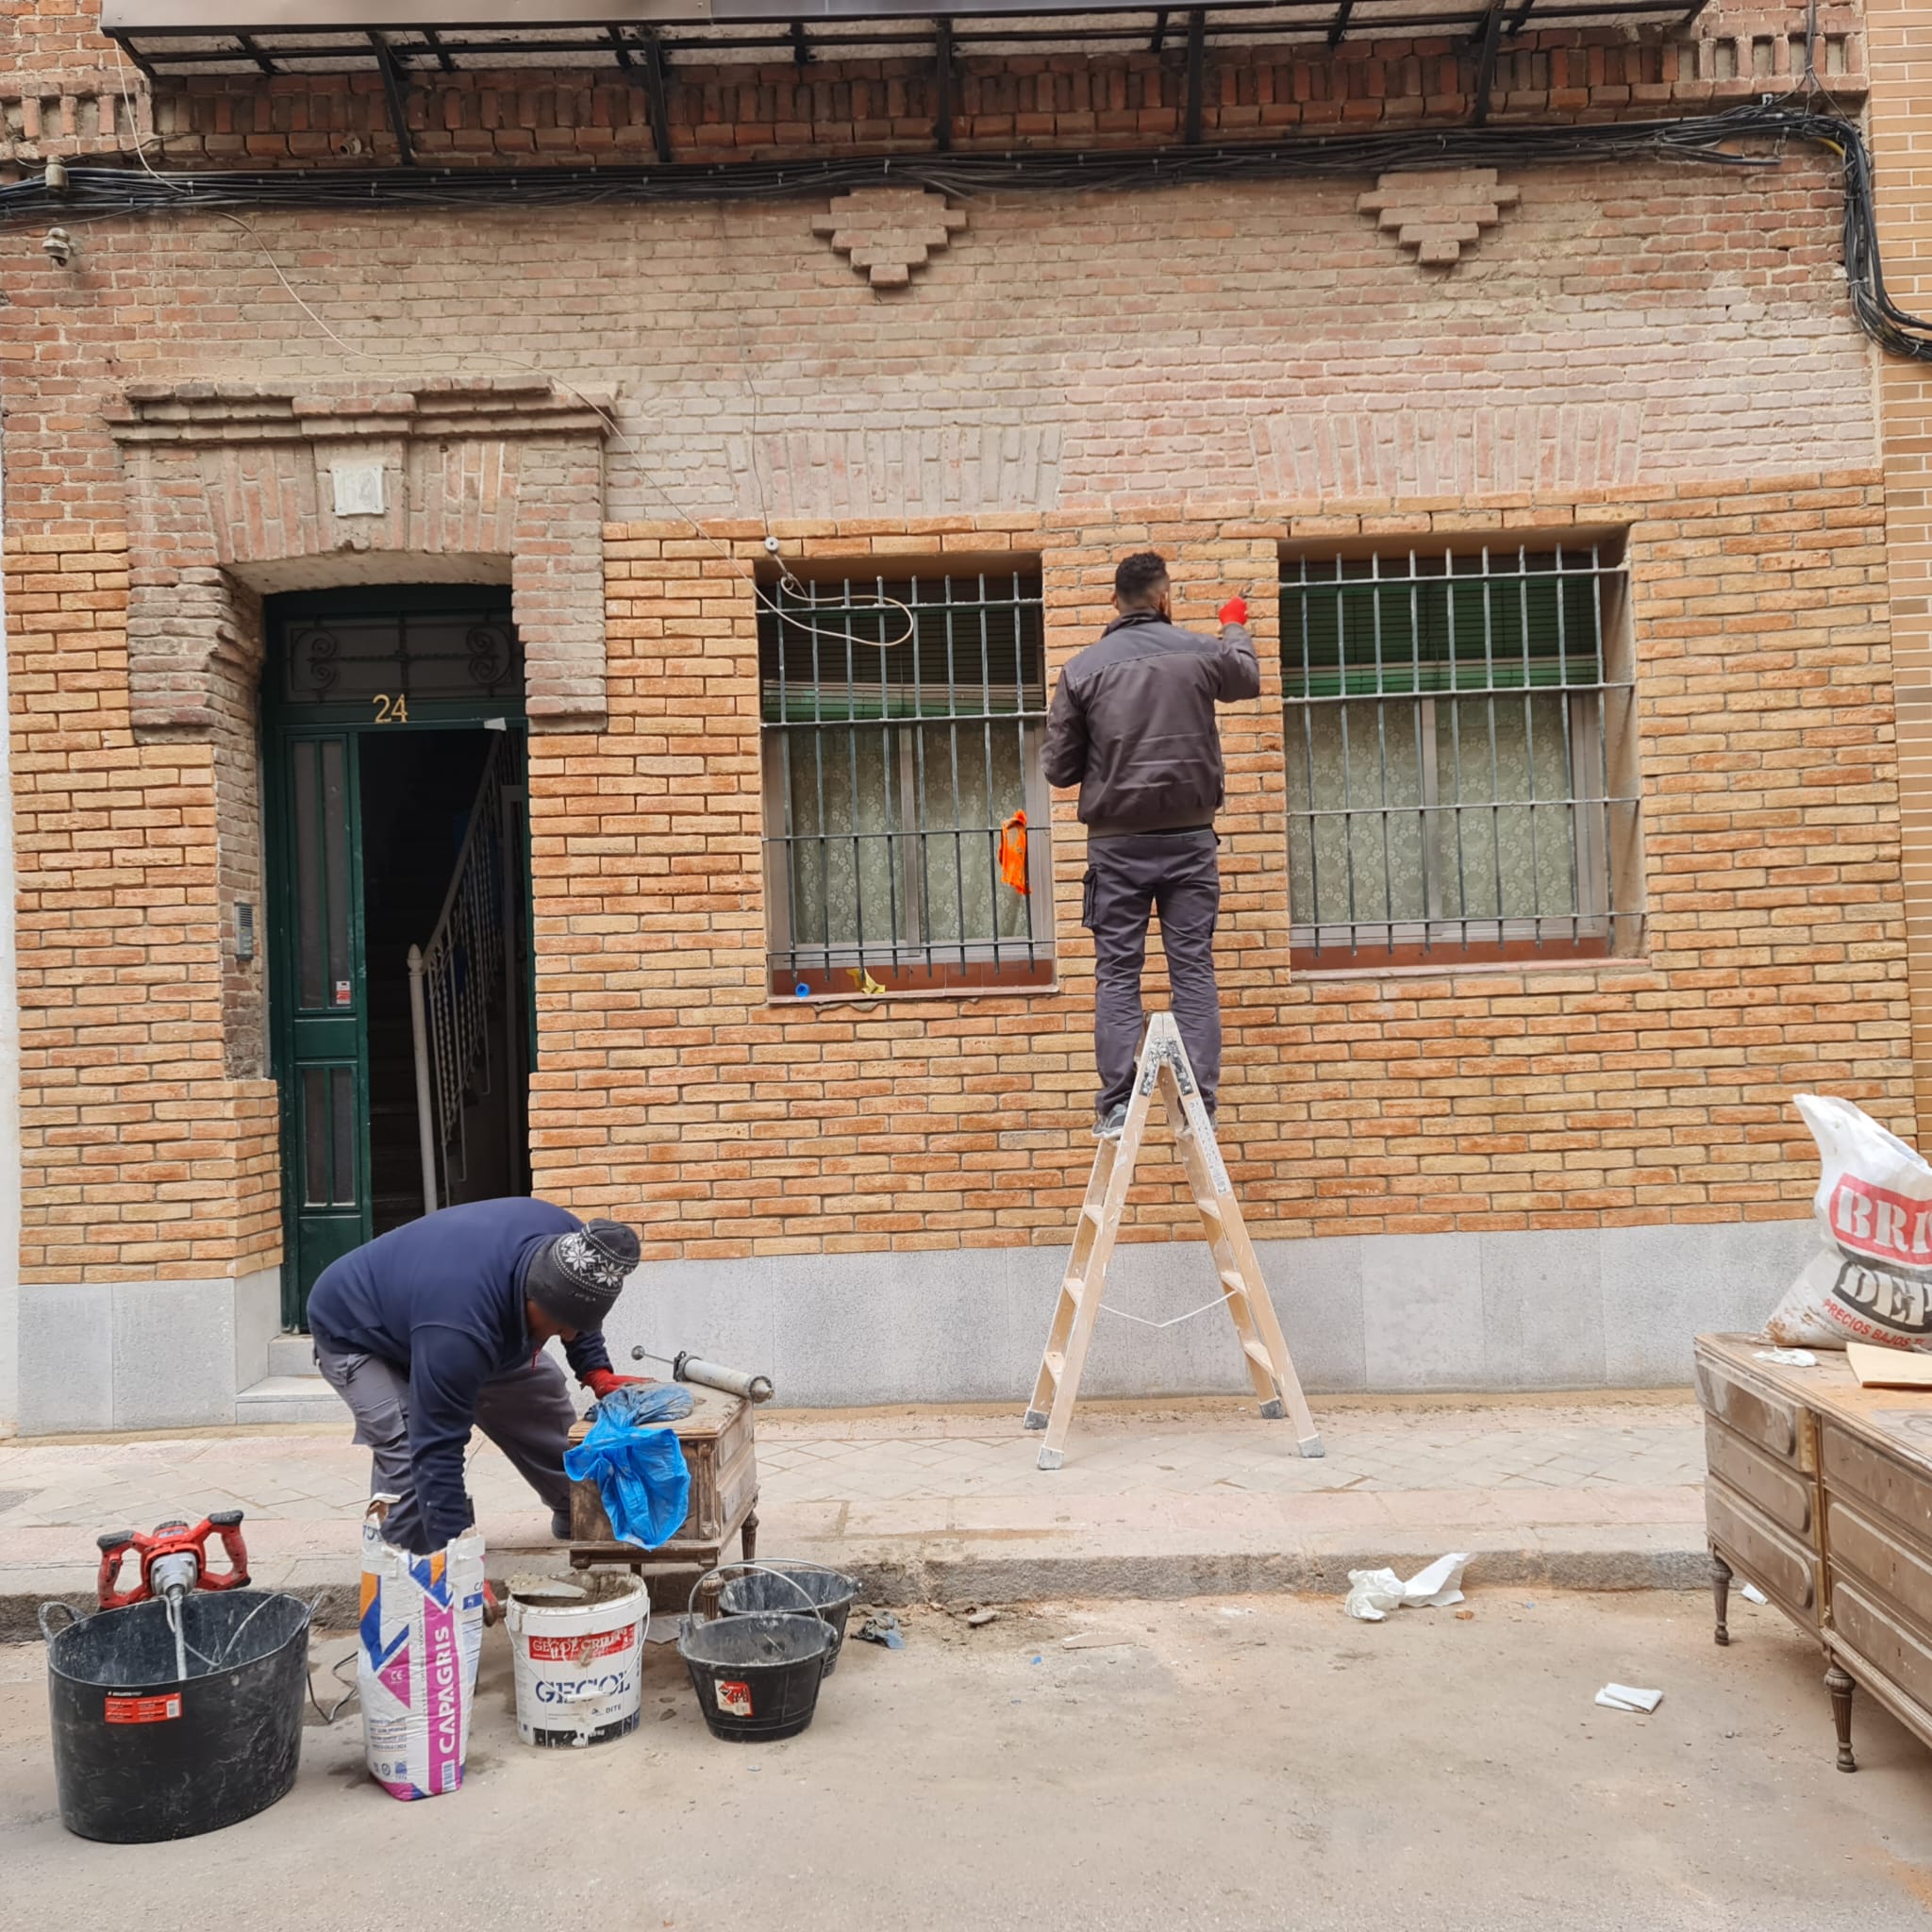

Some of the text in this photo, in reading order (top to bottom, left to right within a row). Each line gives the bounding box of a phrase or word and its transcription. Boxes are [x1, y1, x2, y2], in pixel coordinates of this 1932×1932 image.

[373, 693, 408, 724] 24
[1836, 1185, 1932, 1255] BRI
[1822, 1298, 1911, 1347] PRECIOS BAJOS
[434, 1625, 456, 1754] CAPAGRIS
[535, 1670, 630, 1704] GECOL
